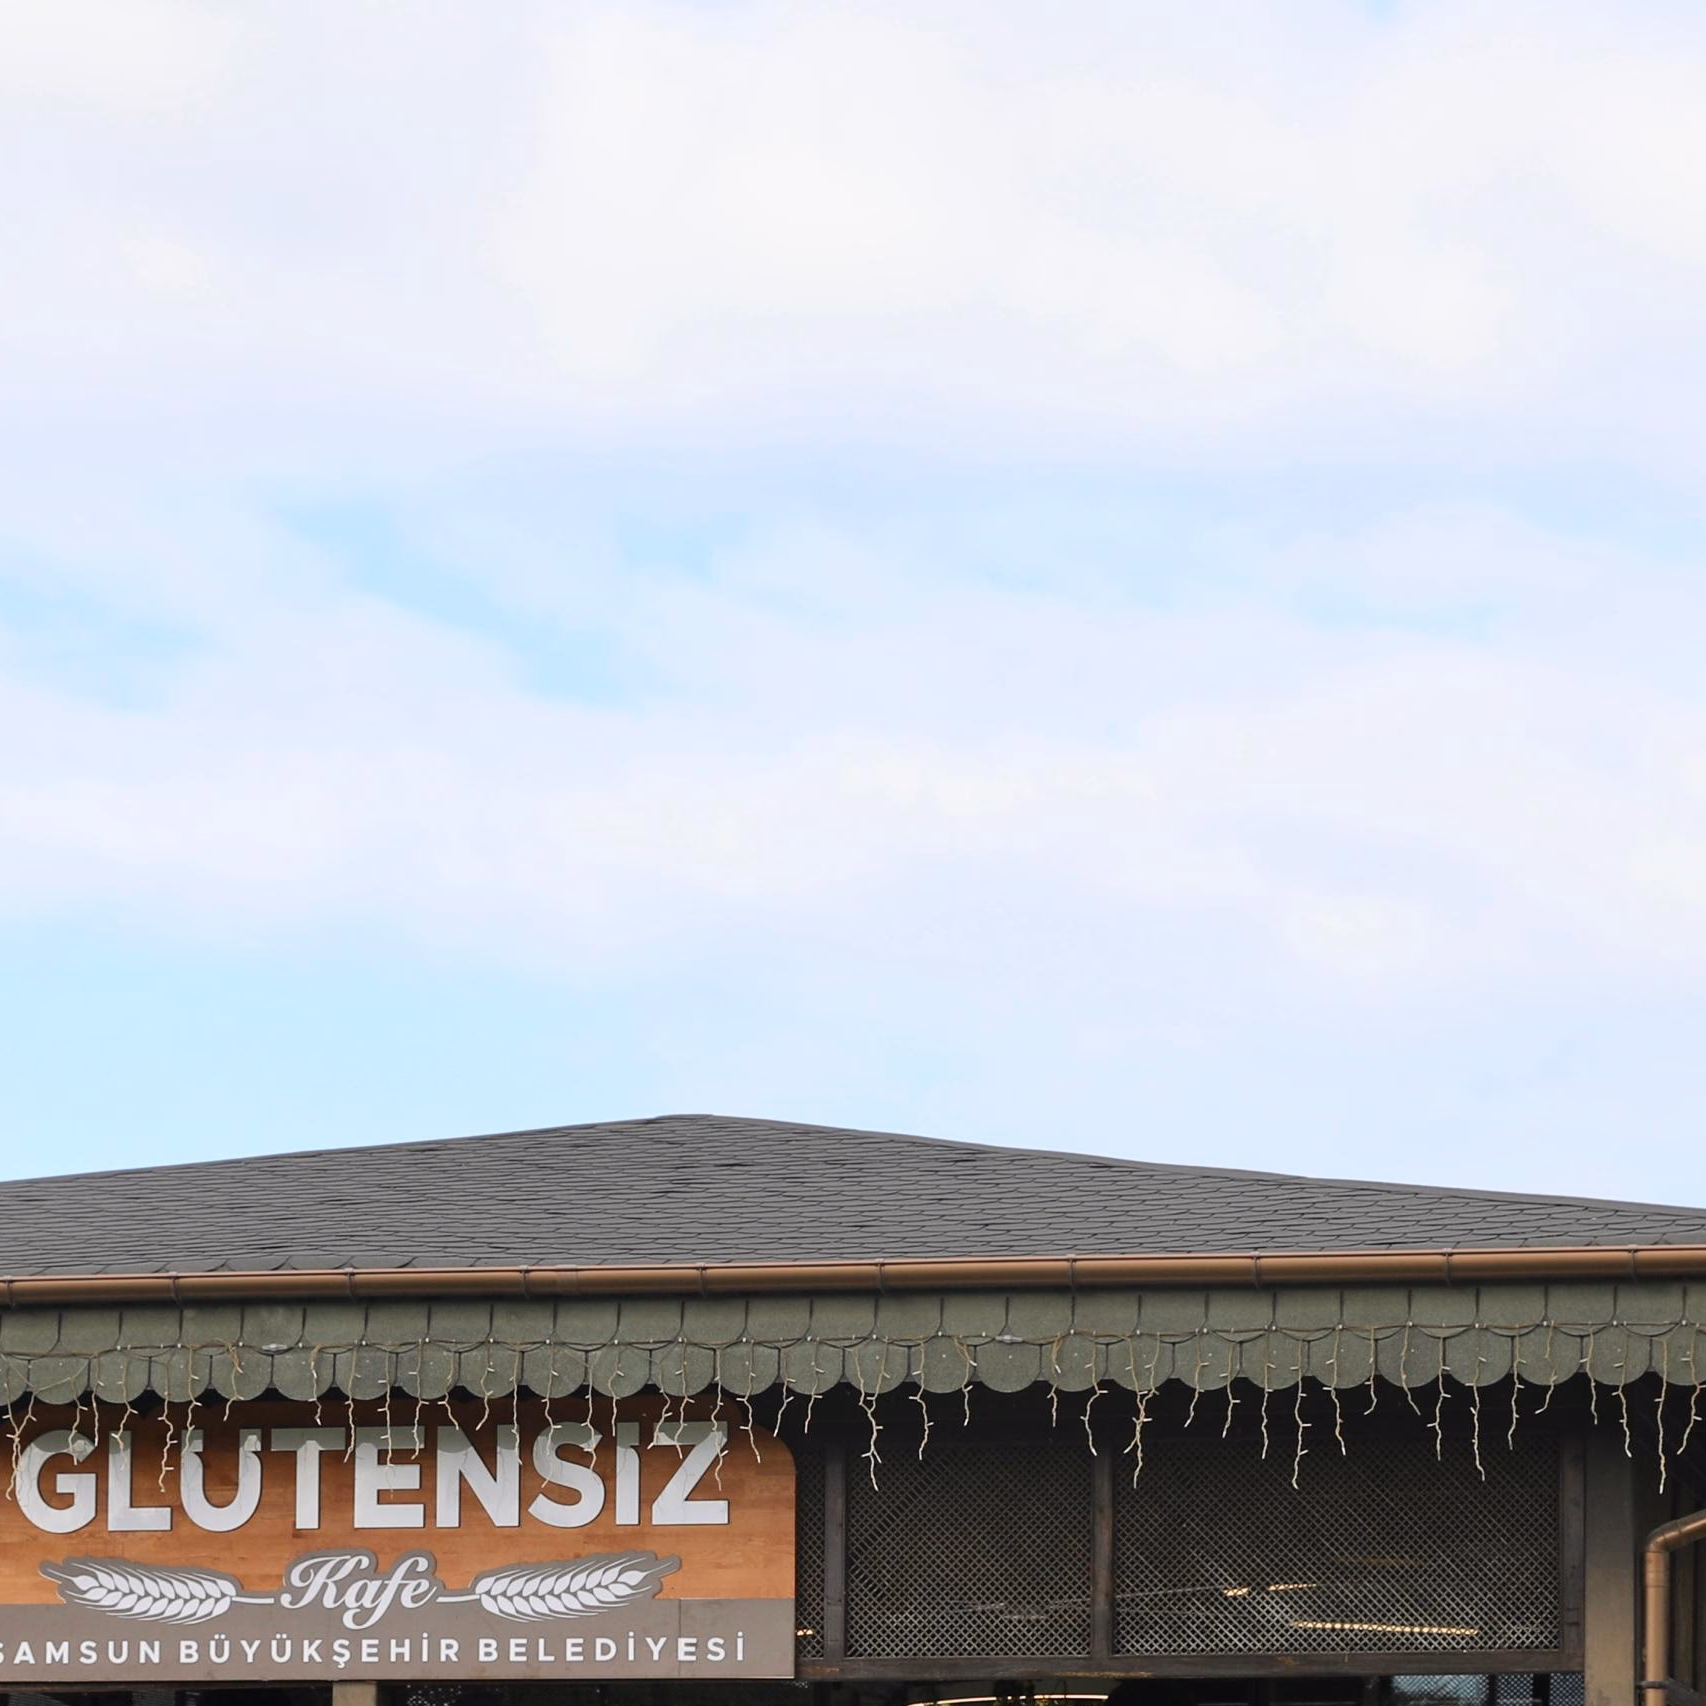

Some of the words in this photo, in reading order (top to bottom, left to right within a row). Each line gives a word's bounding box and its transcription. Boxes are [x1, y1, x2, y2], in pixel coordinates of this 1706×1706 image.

[279, 1554, 438, 1630] Kafe
[179, 1633, 461, 1668] BÜYÜKŞEHİR
[478, 1631, 746, 1663] BELEDİYESİ
